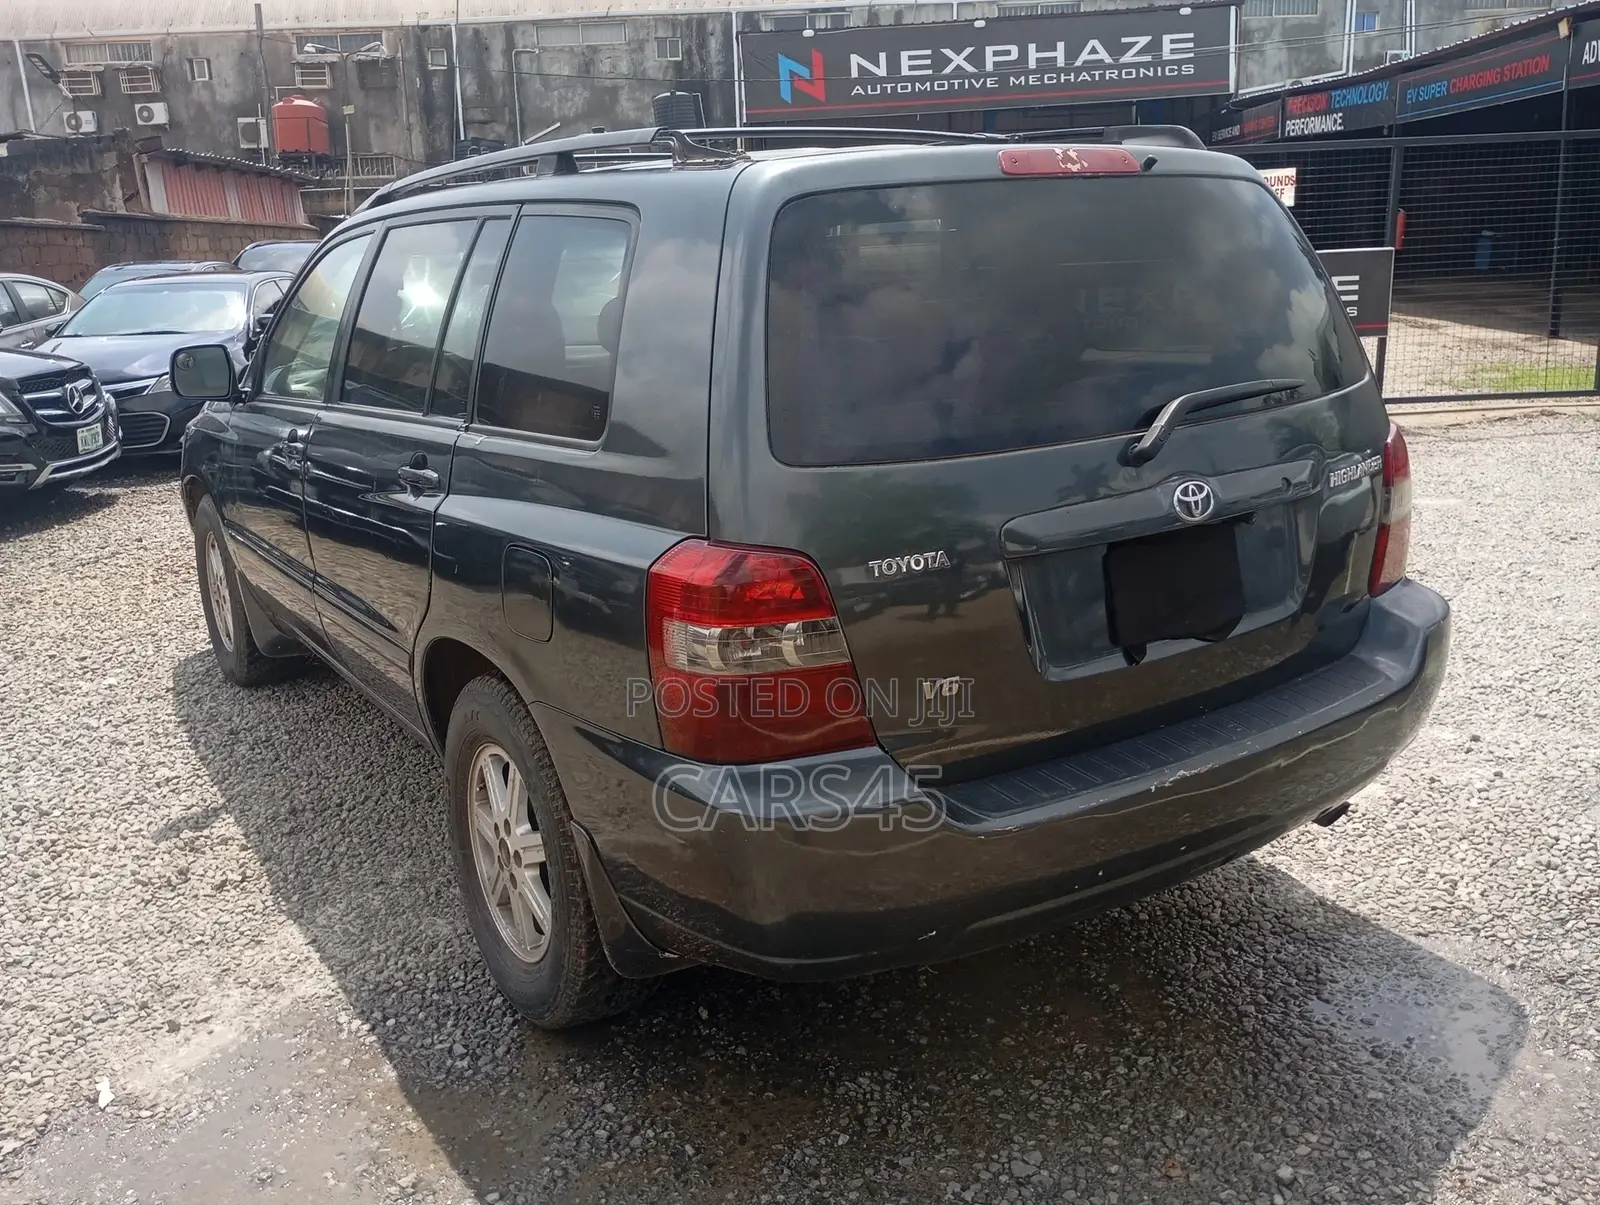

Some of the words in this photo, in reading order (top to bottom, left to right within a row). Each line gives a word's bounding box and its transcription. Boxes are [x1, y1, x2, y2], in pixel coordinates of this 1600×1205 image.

[849, 33, 1196, 79] NEXPHAZE
[850, 77, 1000, 96] AUTOMOTIVE
[1009, 63, 1196, 84] MECHATRONICS
[1406, 90, 1416, 104] EV
[1418, 84, 1448, 102] SUPER
[1449, 68, 1500, 94] CHARGING
[1503, 54, 1550, 82] STATION
[1329, 455, 1383, 487] HIGHLANDER
[868, 550, 950, 578] TOYOTA
[922, 675, 960, 700] V6
